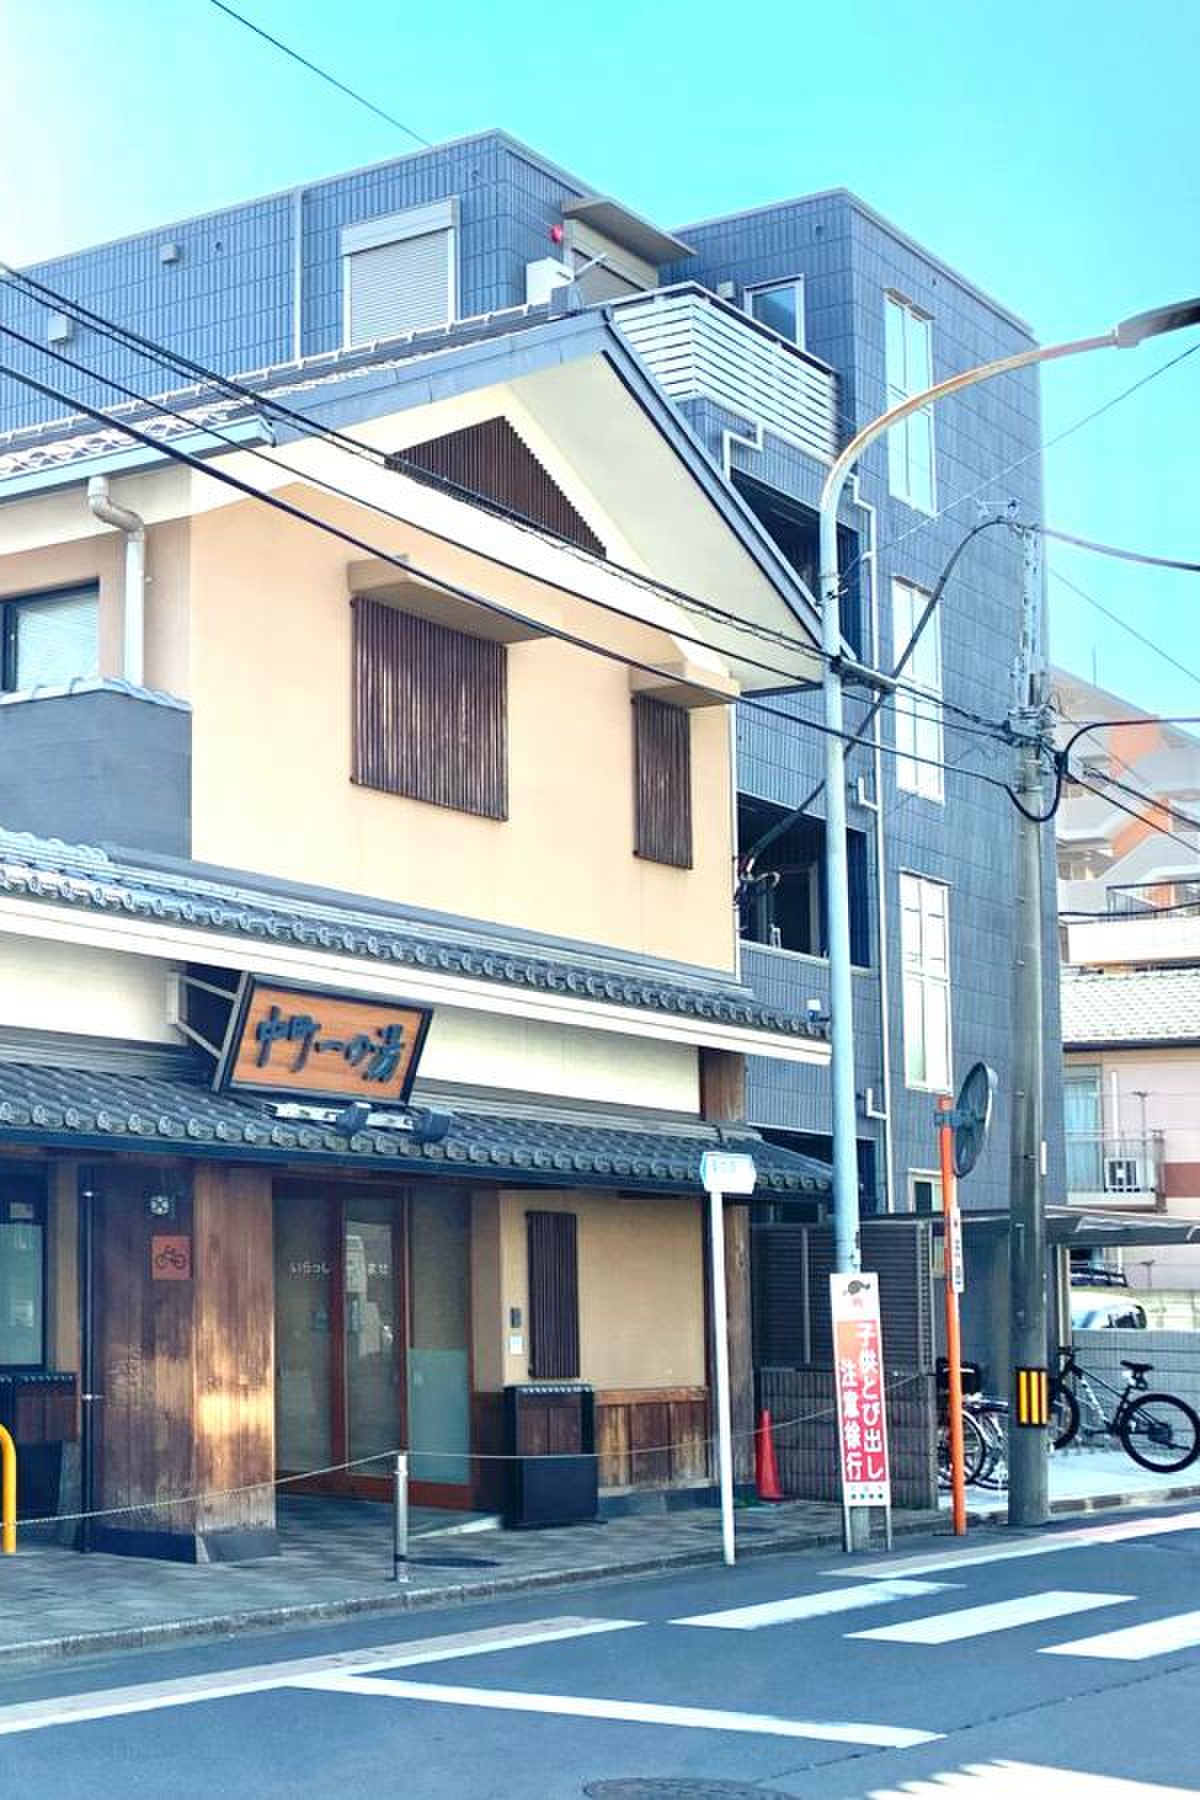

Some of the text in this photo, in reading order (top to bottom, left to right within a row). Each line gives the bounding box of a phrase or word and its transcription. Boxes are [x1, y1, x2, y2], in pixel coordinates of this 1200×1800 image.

[841, 1358, 862, 1480] 注意徐行
[856, 1322, 884, 1480] 子供とび出し
